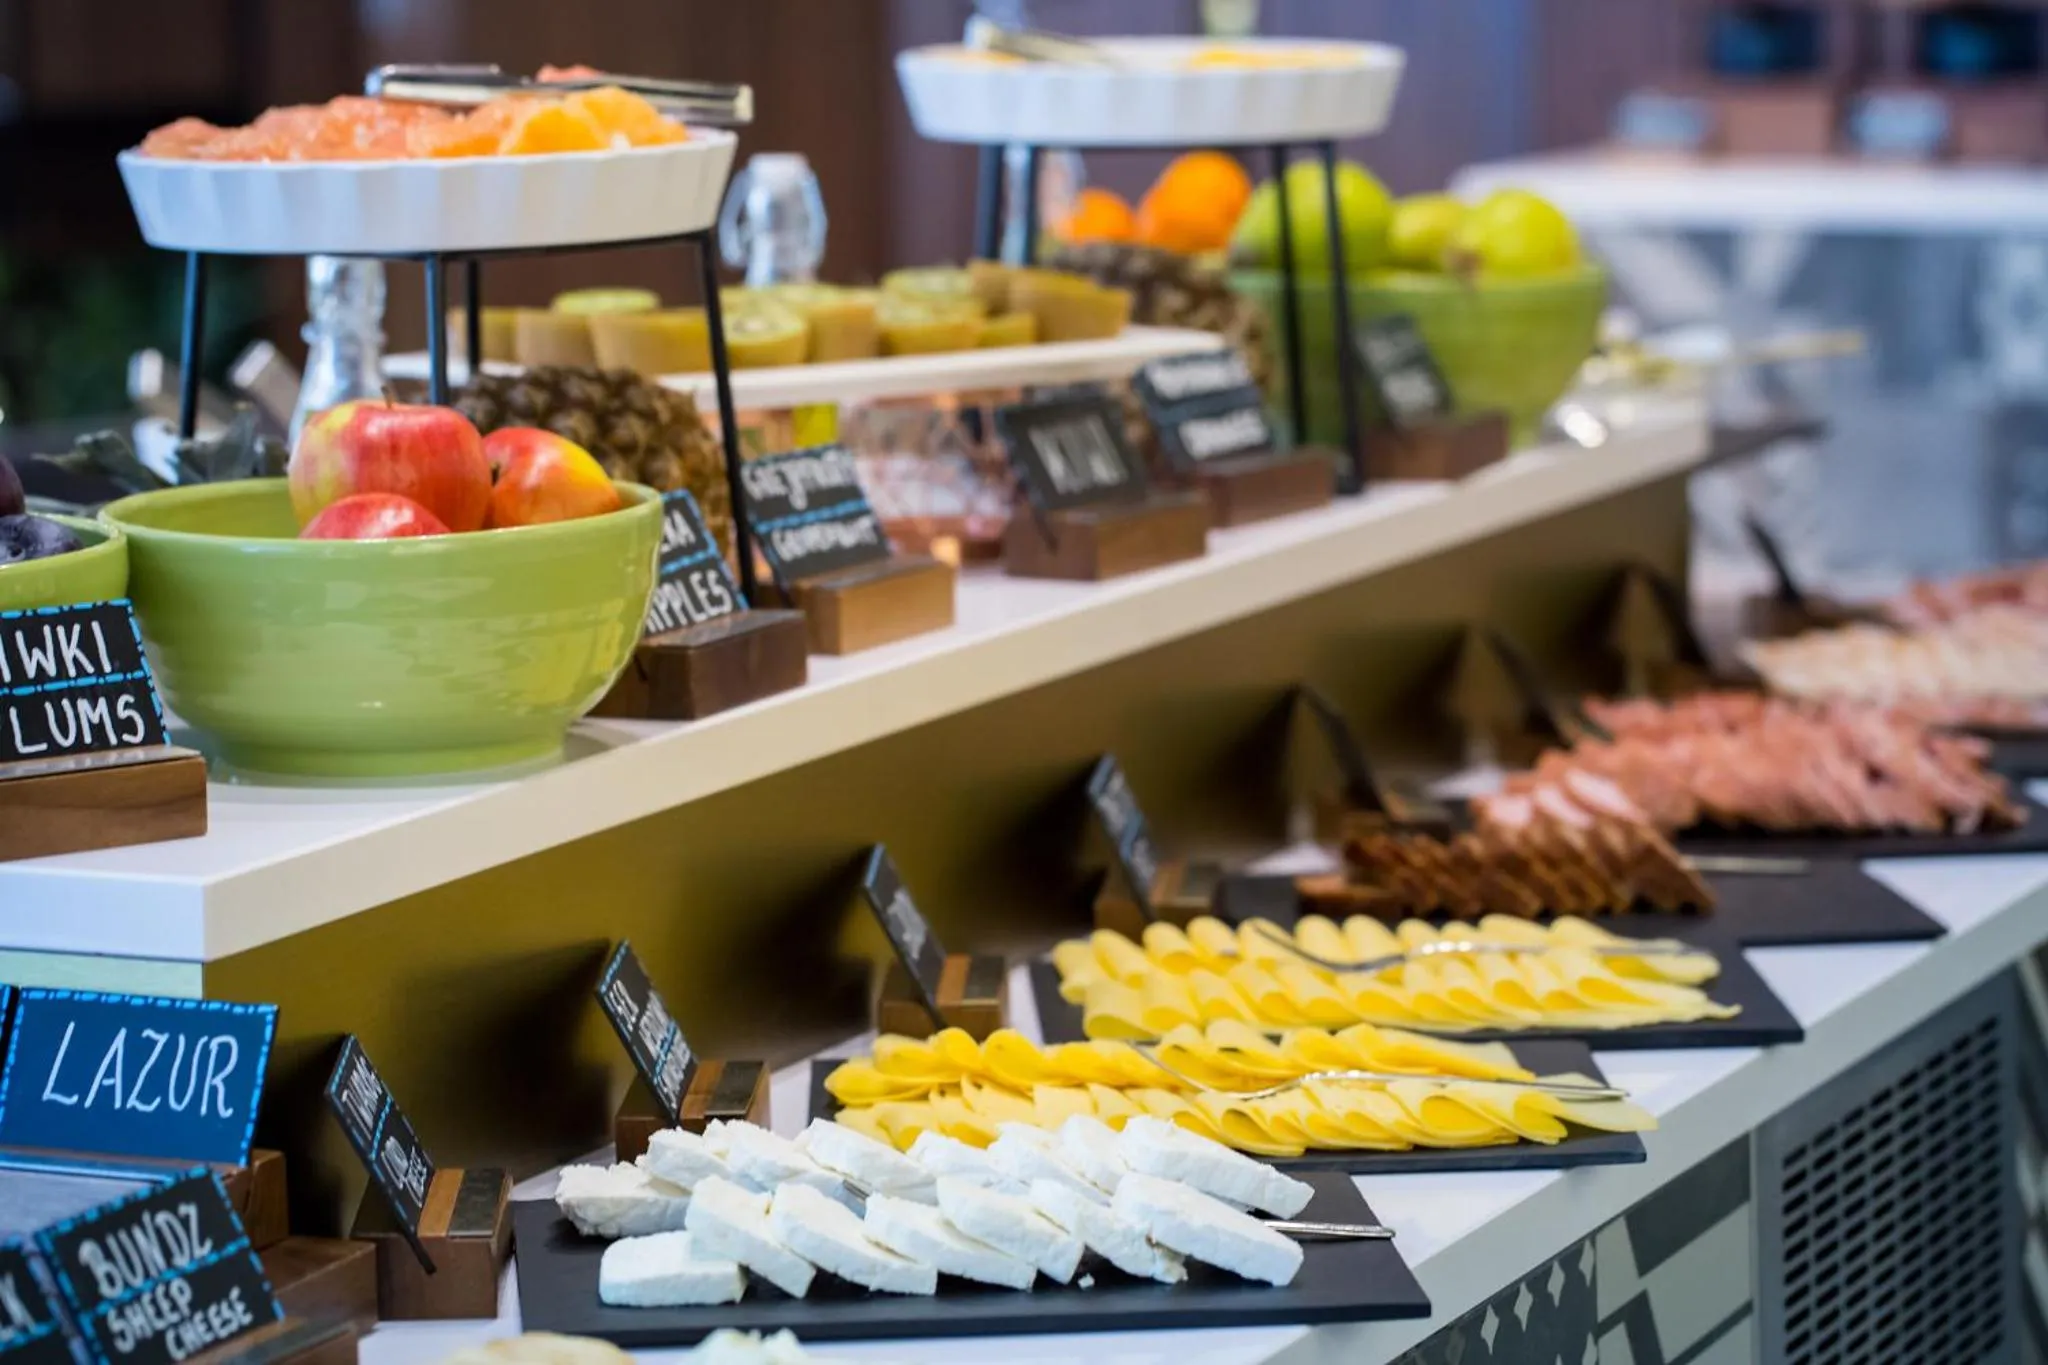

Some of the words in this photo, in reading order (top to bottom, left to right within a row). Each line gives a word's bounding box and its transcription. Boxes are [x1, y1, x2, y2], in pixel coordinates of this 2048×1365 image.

[0, 620, 111, 683] IWKI
[9, 694, 145, 754] LUMS
[42, 1020, 239, 1118] LAZUR
[78, 1202, 214, 1298] BUNDZ
[106, 1277, 193, 1353] SHEEP
[165, 1286, 254, 1361] CHEESE
